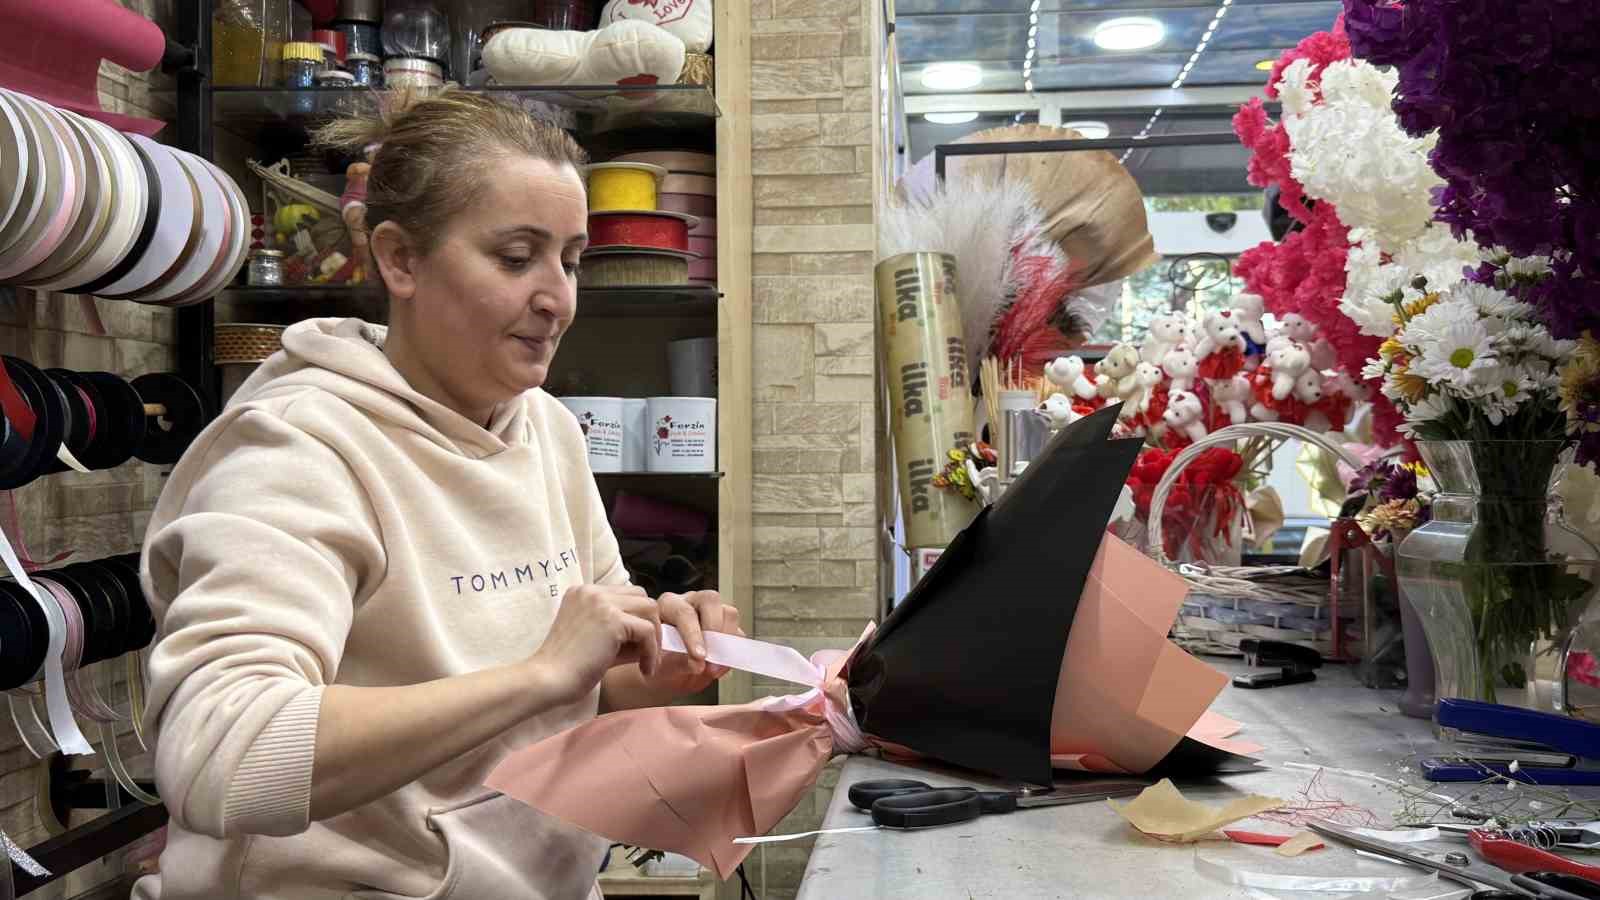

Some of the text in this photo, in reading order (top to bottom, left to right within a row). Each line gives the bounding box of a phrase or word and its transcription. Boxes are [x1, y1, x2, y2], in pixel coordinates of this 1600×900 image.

[894, 267, 921, 323] ilka
[901, 362, 928, 418] ilka
[908, 459, 934, 515] ilka
[451, 560, 549, 594] TOMMY
